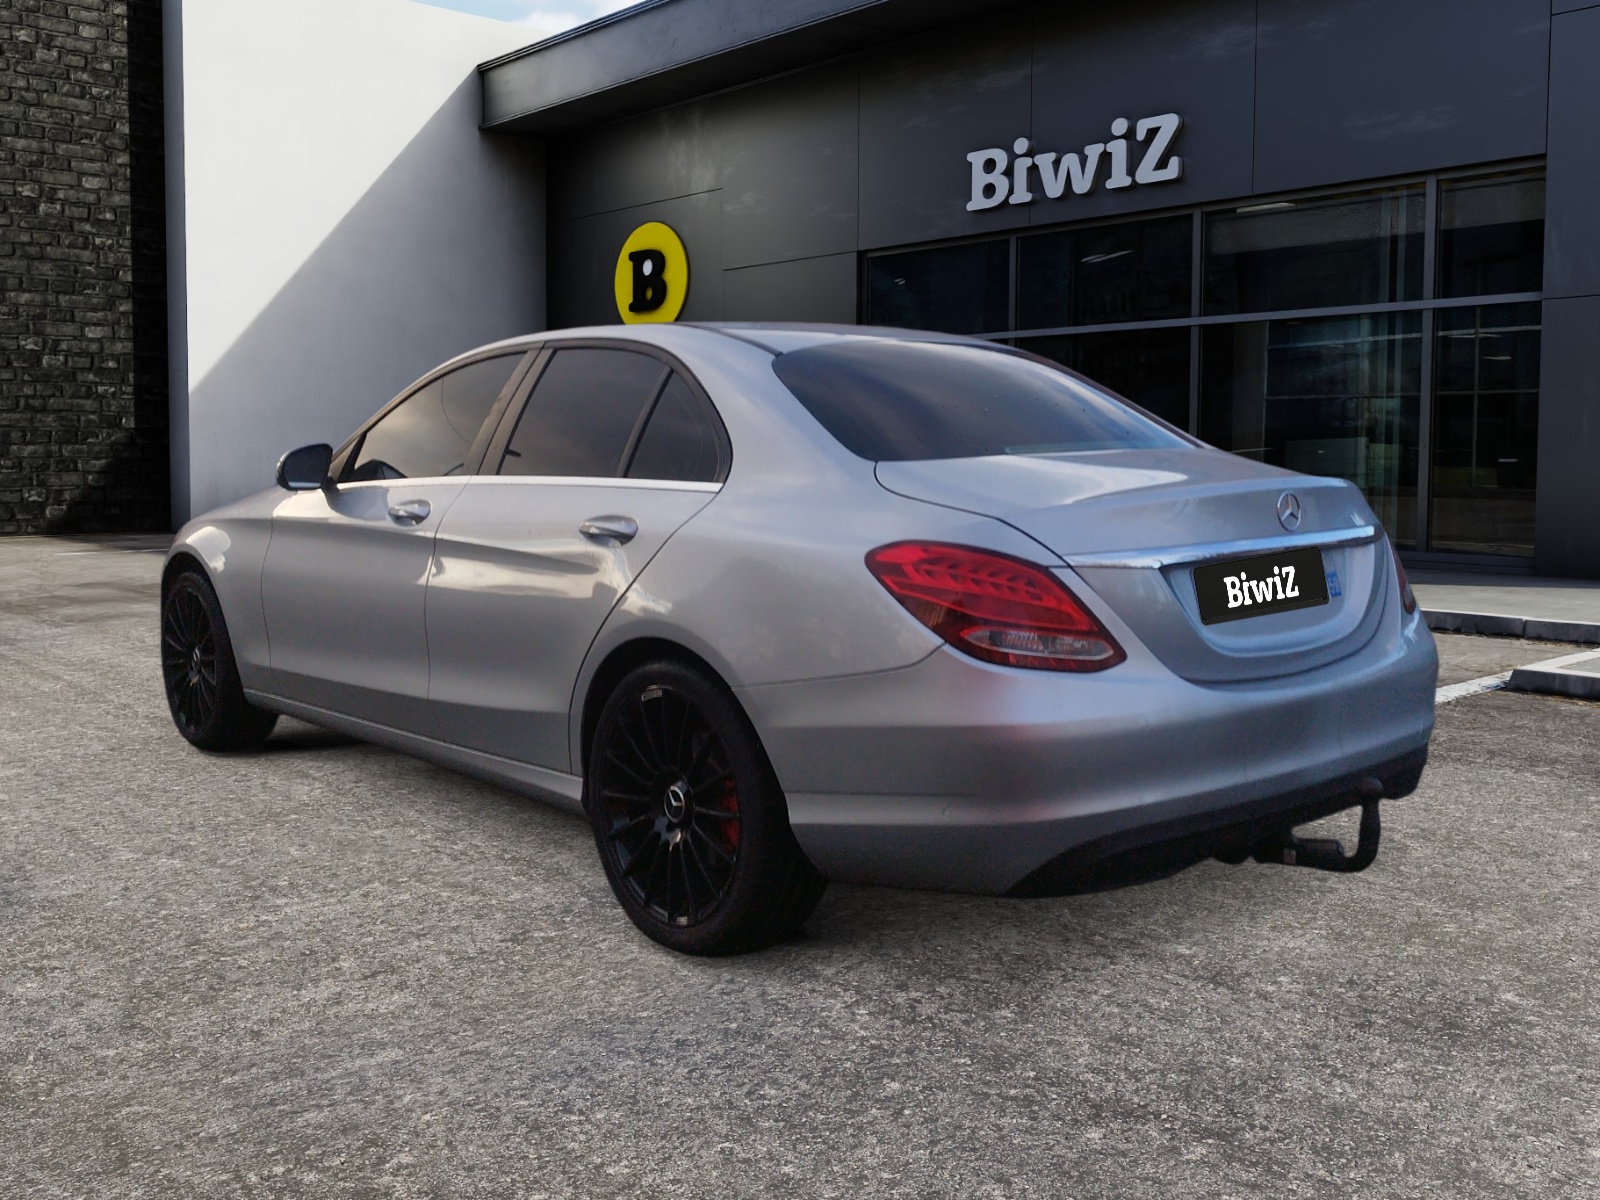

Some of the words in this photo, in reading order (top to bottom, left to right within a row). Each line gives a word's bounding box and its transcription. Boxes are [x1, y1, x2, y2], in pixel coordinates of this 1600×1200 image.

[966, 113, 1183, 212] BiwiZ
[628, 249, 667, 313] B
[1223, 565, 1300, 609] BiwiZ
